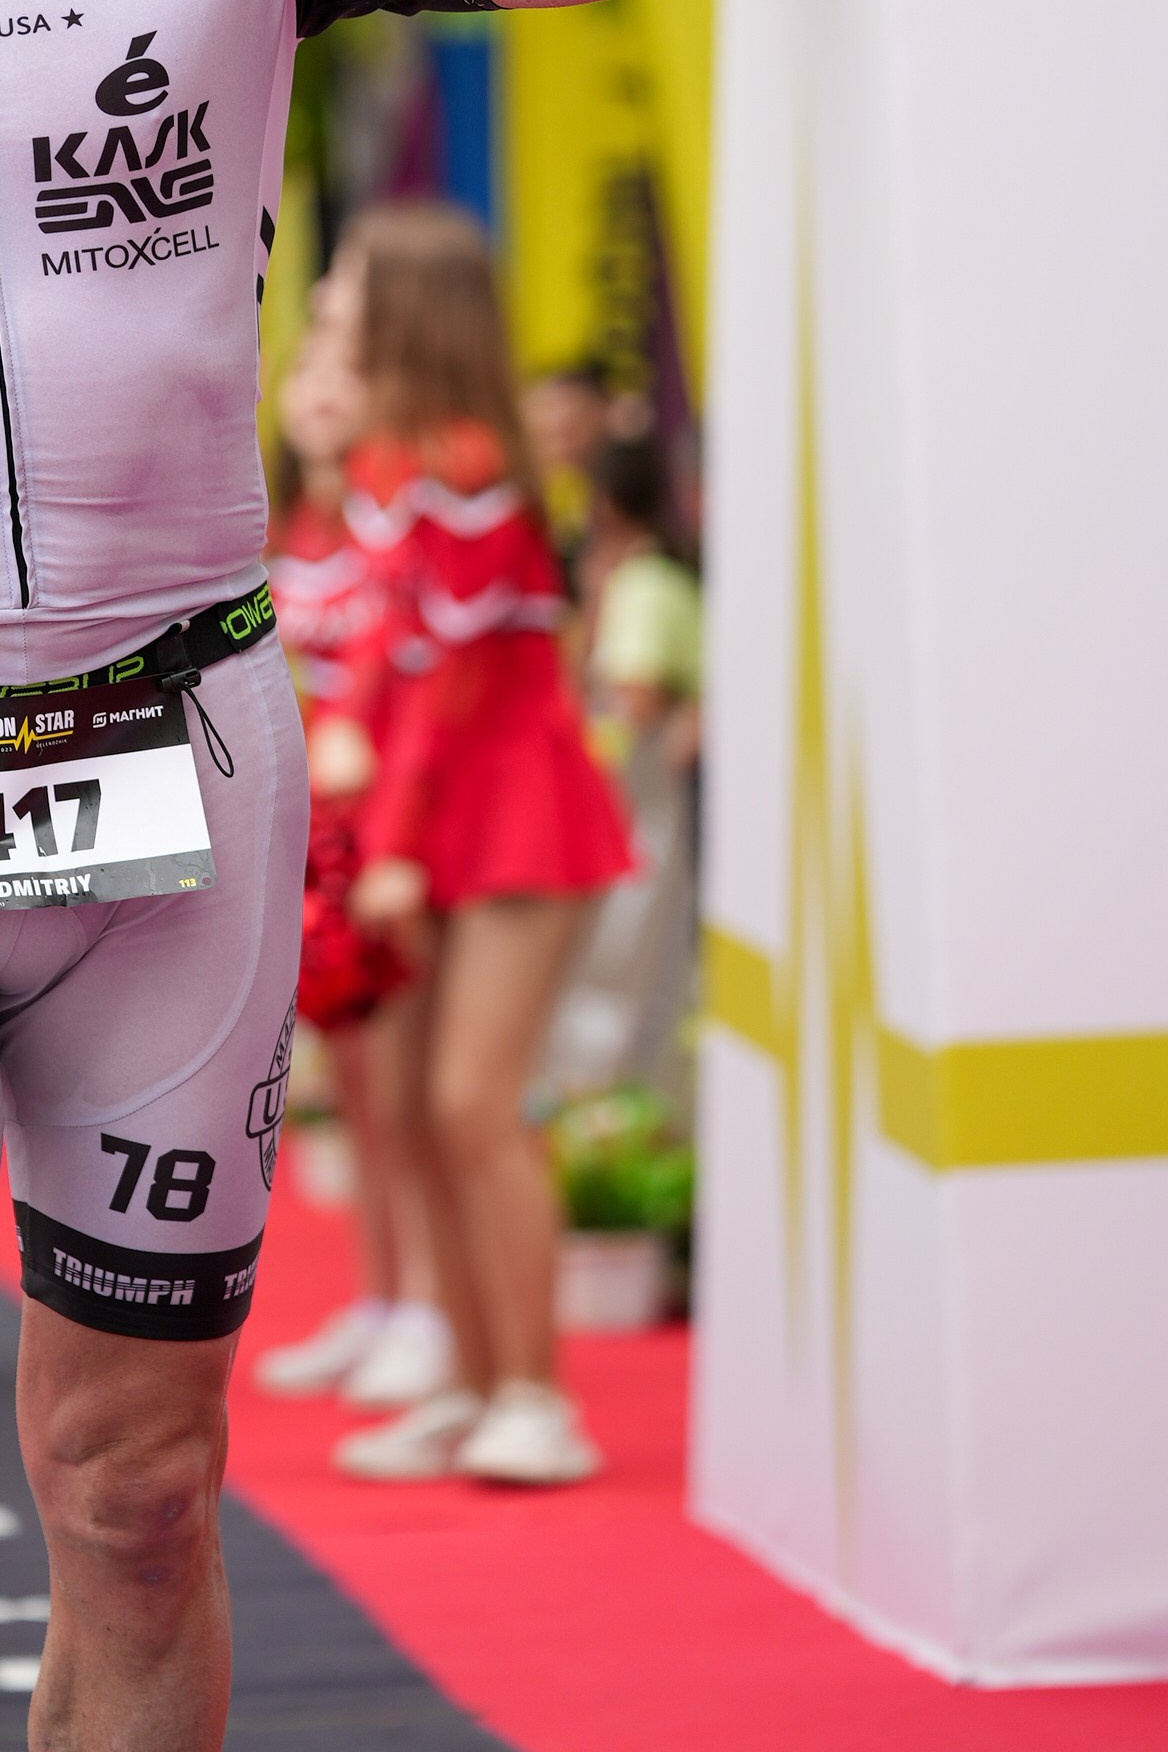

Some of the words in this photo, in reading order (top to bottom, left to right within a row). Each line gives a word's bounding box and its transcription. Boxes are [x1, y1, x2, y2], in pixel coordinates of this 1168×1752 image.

[32, 100, 211, 183] KASK
[35, 710, 75, 734] STAR
[110, 705, 164, 724] МАГНИТ
[179, 878, 197, 889] 113
[100, 1132, 216, 1222] 78
[52, 1247, 196, 1306] TRIUMPH
